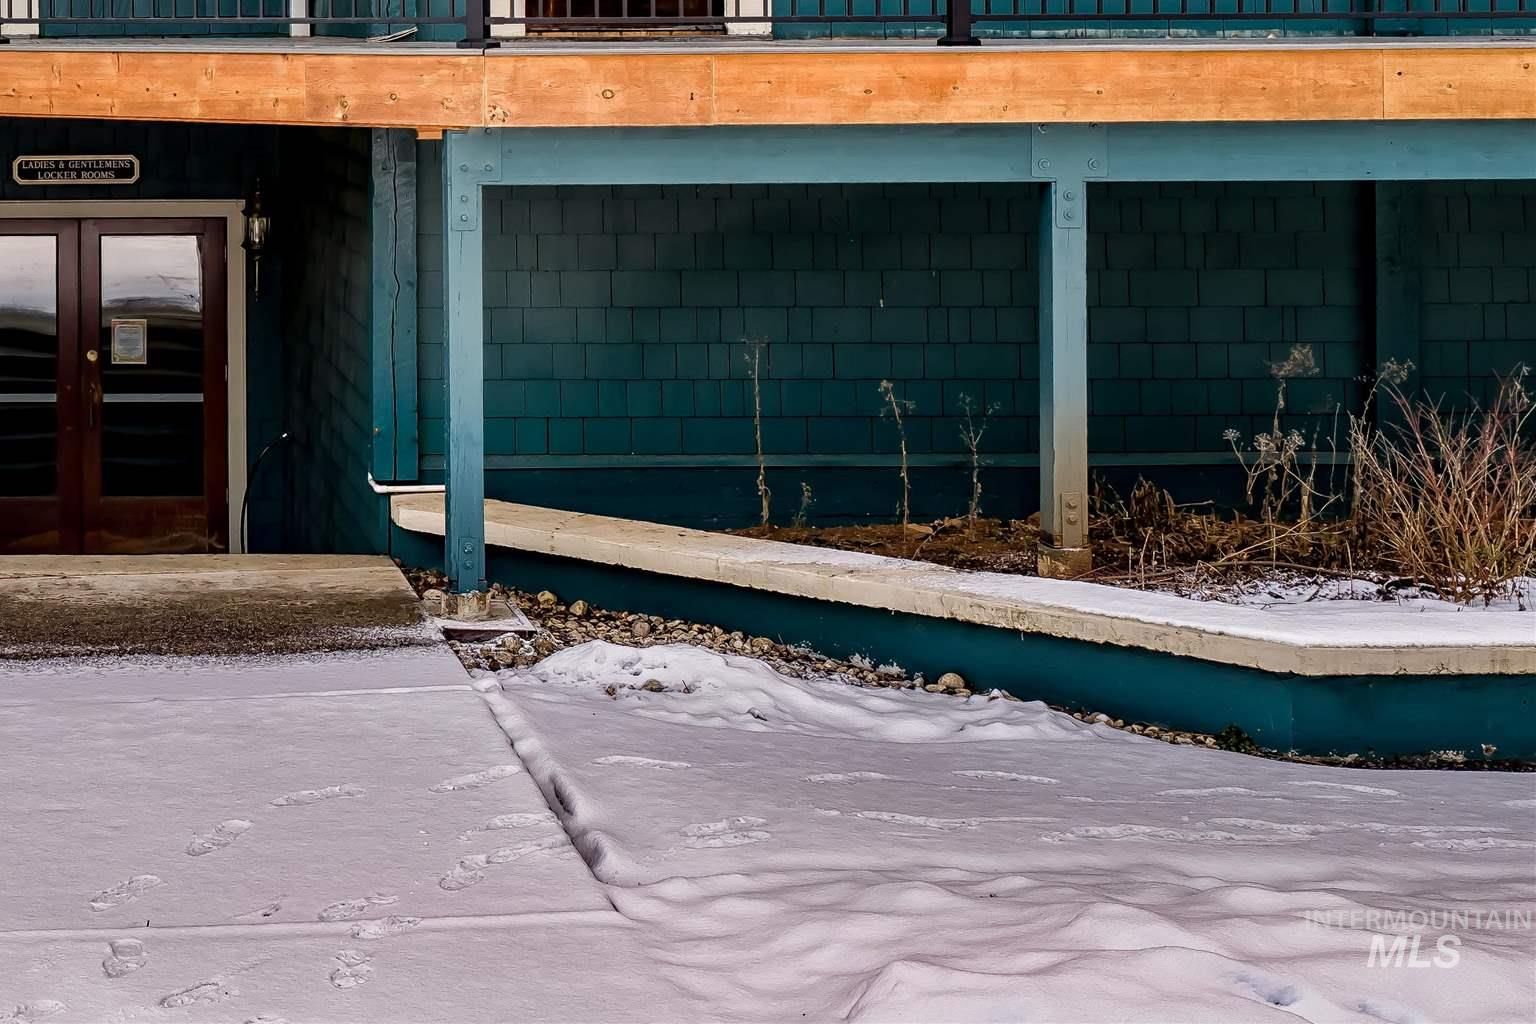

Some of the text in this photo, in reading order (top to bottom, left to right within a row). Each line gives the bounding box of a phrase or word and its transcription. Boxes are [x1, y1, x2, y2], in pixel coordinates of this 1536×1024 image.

[21, 160, 131, 169] LADIES & GENTLEMENS
[37, 170, 116, 180] LOCKER ROOMS
